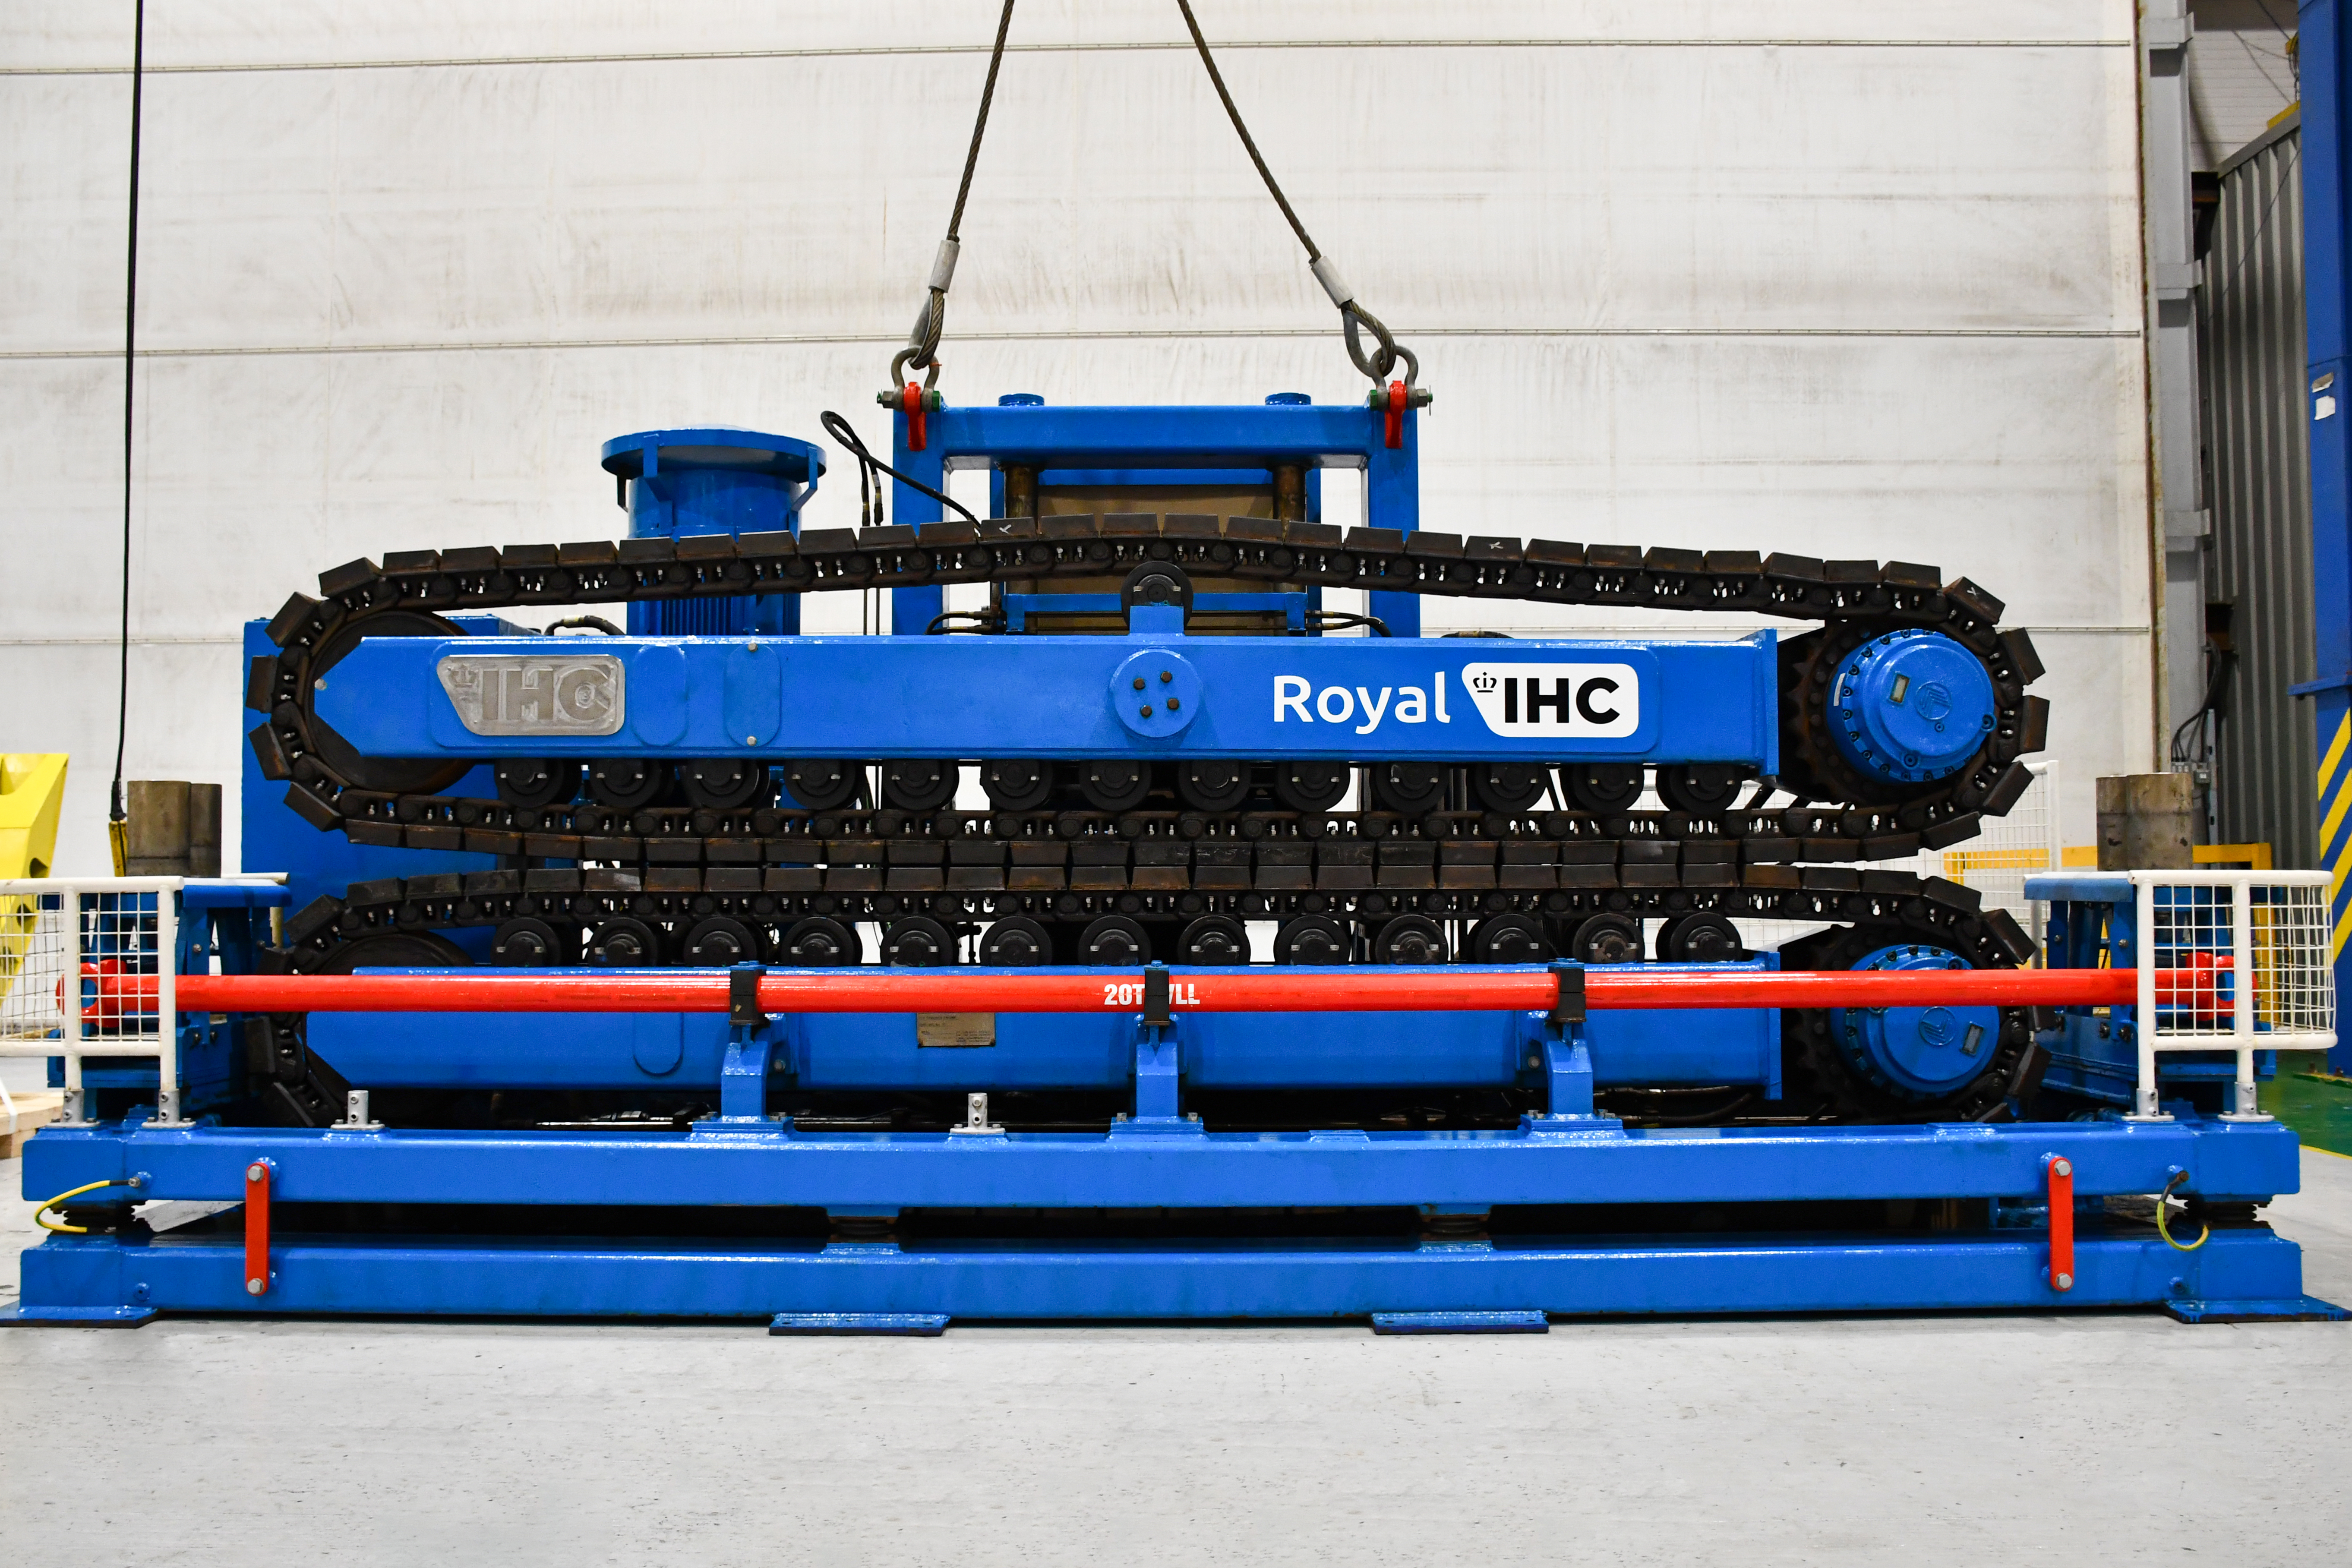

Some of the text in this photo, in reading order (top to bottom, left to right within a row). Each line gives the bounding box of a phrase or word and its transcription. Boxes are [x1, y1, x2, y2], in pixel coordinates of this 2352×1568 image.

[482, 668, 610, 721] IHC
[1274, 671, 1620, 735] Royal IHC
[1104, 983, 1200, 1005] 20T LL
